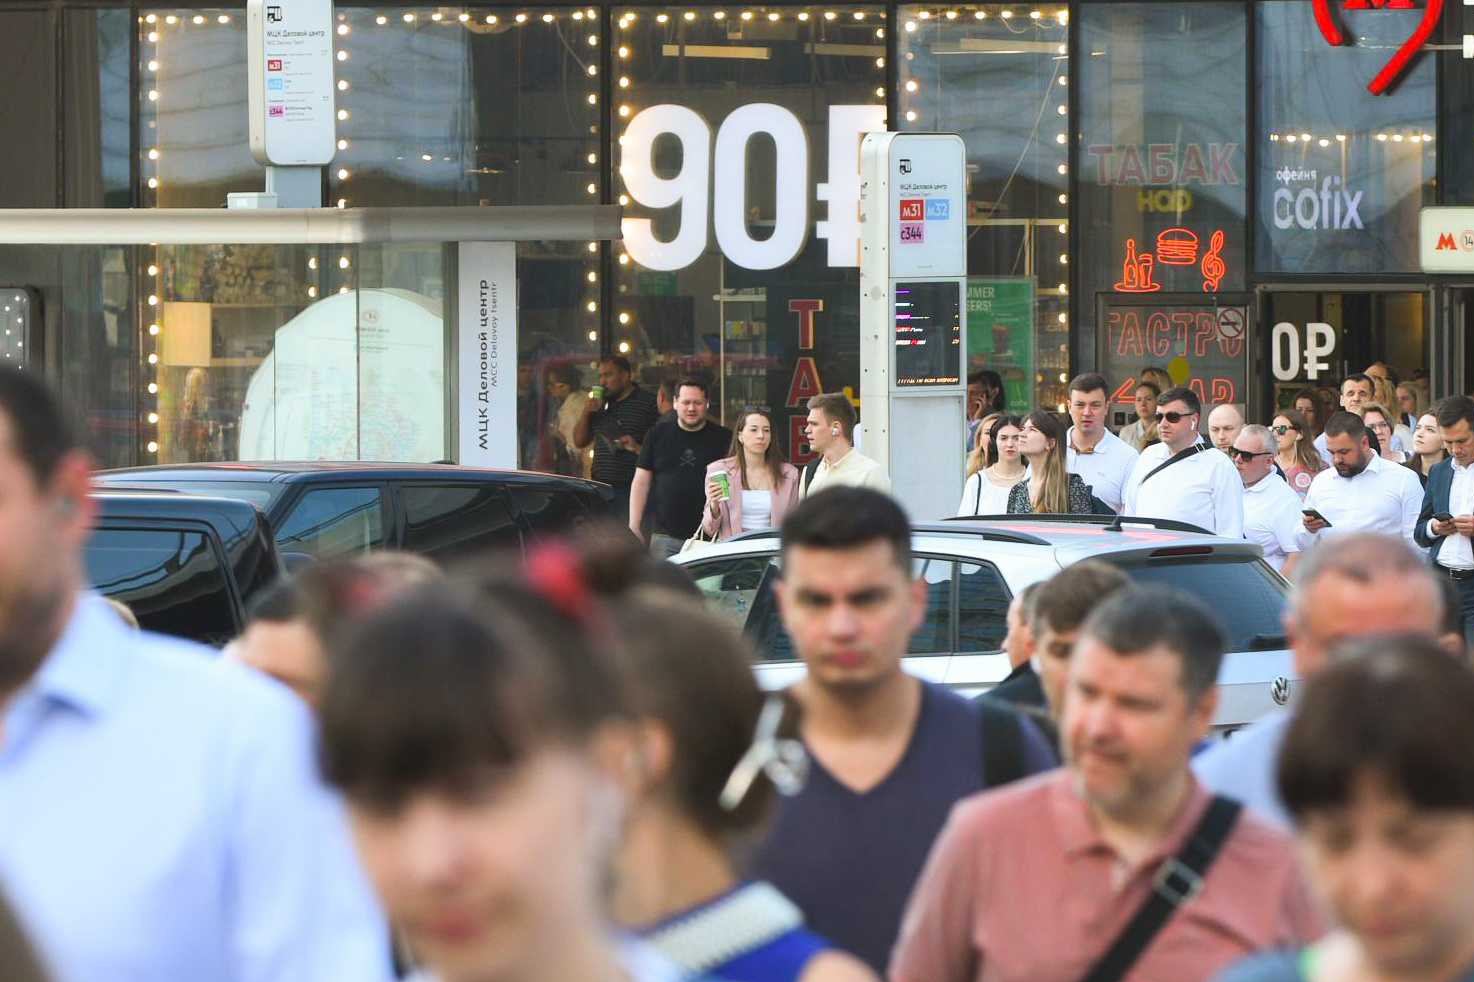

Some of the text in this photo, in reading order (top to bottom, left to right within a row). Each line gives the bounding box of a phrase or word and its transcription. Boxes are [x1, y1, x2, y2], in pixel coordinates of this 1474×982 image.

[1088, 143, 1240, 186] ТАБАК
[1274, 174, 1364, 230] cofix
[490, 316, 499, 359] Delovoy
[477, 279, 490, 450] МЦК Деловой центр
[490, 363, 498, 388] MCC
